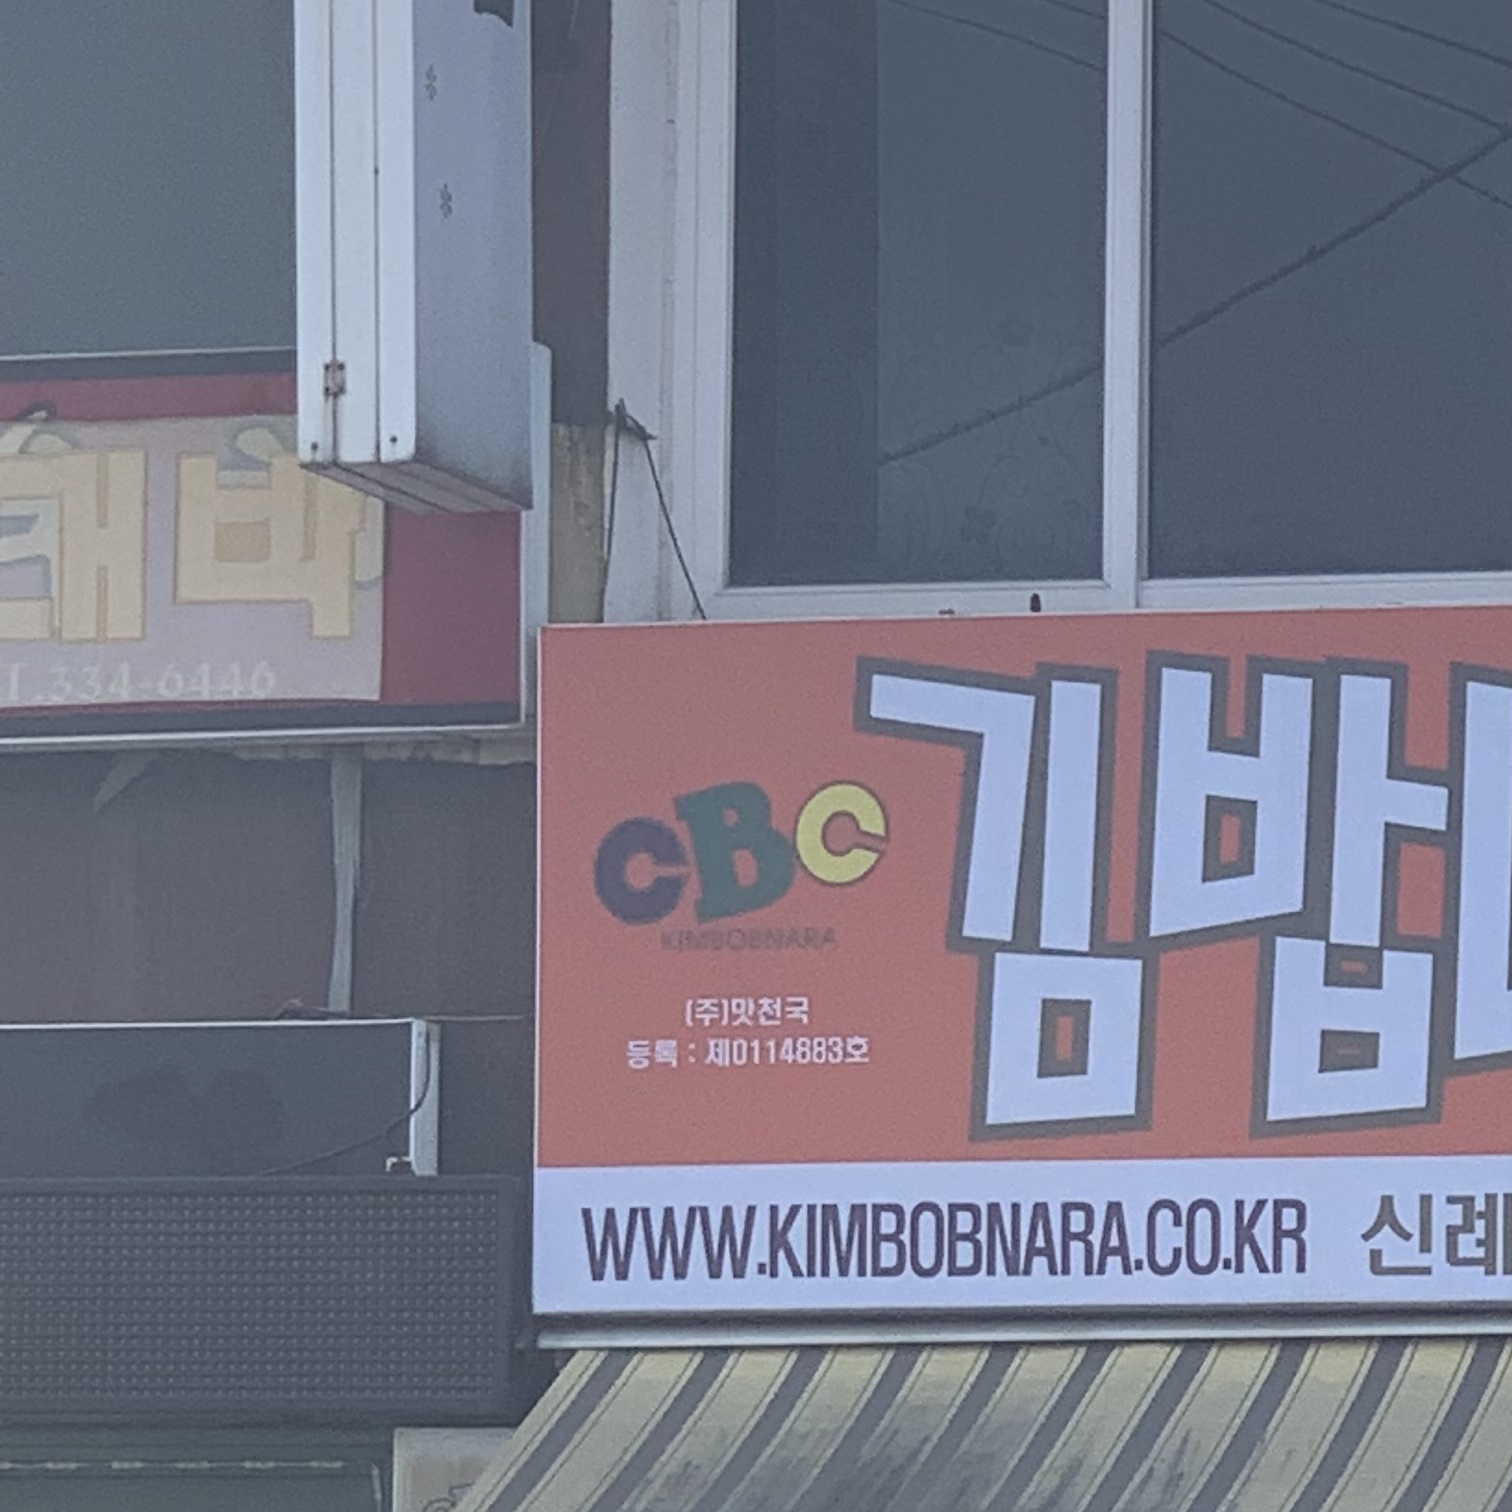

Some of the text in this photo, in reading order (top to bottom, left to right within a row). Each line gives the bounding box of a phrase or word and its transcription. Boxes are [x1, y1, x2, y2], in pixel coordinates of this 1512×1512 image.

[593, 779, 889, 925] CBC
[684, 997, 811, 1027] (주)맛천국
[626, 1040, 680, 1070] 등록
[581, 1198, 1307, 1283] WWW.KIMBOBNARA.CO.KR
